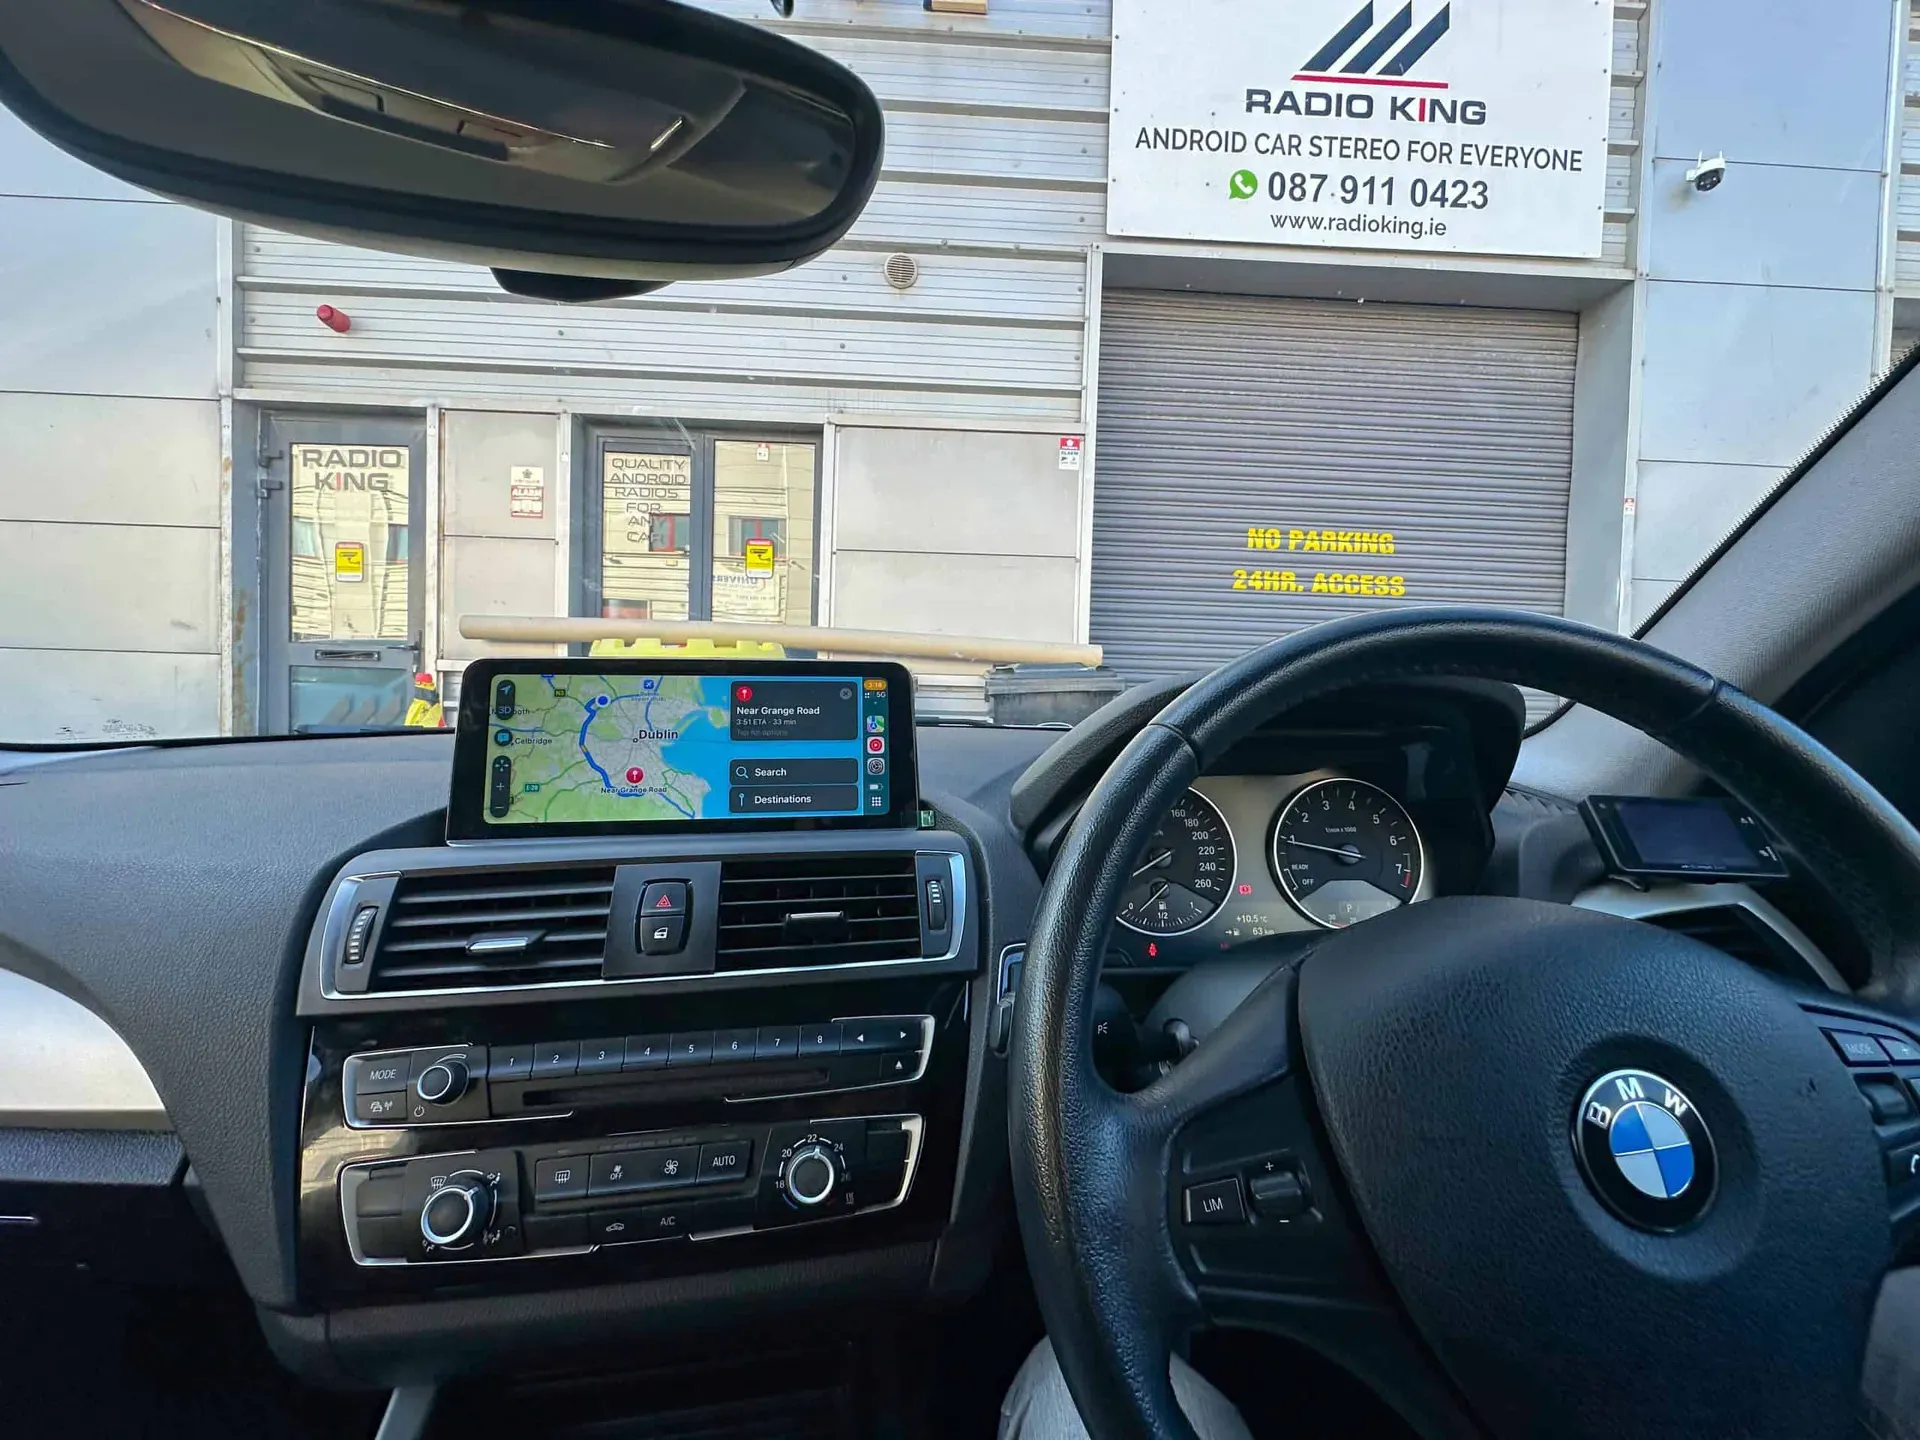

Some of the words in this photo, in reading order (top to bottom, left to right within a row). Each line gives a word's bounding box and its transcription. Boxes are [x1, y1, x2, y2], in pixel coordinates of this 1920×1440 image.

[1245, 88, 1374, 119] RADIO
[1390, 96, 1487, 126] KING
[1135, 126, 1247, 154] ANDROID
[1254, 133, 1302, 157] CAR
[1308, 135, 1400, 161] STEREO
[1407, 140, 1453, 165] FOR
[1459, 144, 1582, 172] EVERYONE
[1268, 171, 1327, 203] 087
[1340, 175, 1394, 206] 911
[1410, 179, 1489, 210] 0423
[1270, 211, 1447, 240] www.radioking.ie
[302, 449, 402, 468] RADIO
[611, 457, 686, 470] QUALITY
[314, 472, 389, 491] KING
[610, 473, 686, 485] ANDROID
[614, 487, 679, 498] RADIOS
[626, 502, 661, 513] FOR
[1247, 527, 1282, 550] NO
[1288, 529, 1395, 554] PARKING
[1231, 568, 1304, 592] 24HR.
[1310, 572, 1406, 597] ACCESS
[736, 706, 759, 715] Near
[760, 706, 795, 717] Grange
[796, 706, 821, 715] Road
[736, 718, 752, 726] 3:51
[753, 718, 767, 726] ETA
[772, 718, 782, 726] 33
[783, 718, 797, 726] min
[639, 729, 679, 740] Dublin
[514, 737, 553, 746] Celbridge
[754, 768, 787, 777] Search
[754, 795, 812, 805] Destinations
[1322, 800, 1331, 811] 3
[1348, 800, 1356, 811] 4
[1171, 809, 1186, 818] 160
[1301, 812, 1310, 823] 2
[1184, 818, 1199, 828] 180
[1372, 814, 1380, 825] 5
[1191, 831, 1209, 840] 200
[1389, 835, 1398, 846] 6
[1198, 846, 1215, 856] 220
[1199, 862, 1216, 871] 240
[1291, 863, 1309, 871] READY
[1395, 863, 1402, 875] 7
[1194, 879, 1212, 888] 260
[1301, 878, 1314, 886] OFF
[1128, 901, 1134, 910] 0
[1190, 901, 1194, 910] 1
[1158, 911, 1169, 920] 1/2
[1236, 914, 1260, 924] +10.5
[1252, 927, 1264, 936] 63
[774, 1038, 780, 1047] 7
[817, 1034, 823, 1044] 8
[688, 1044, 694, 1053] 5
[731, 1041, 738, 1051] 6
[598, 1050, 605, 1060] 3
[644, 1047, 651, 1056] 4
[509, 1057, 515, 1067] 1
[552, 1054, 559, 1064] 2
[369, 1068, 397, 1080] MODE
[1586, 1077, 1688, 1129] BMW
[807, 1134, 817, 1143] 22
[833, 1143, 844, 1152] 24
[781, 1148, 792, 1158] 20
[712, 1155, 736, 1167] AUTO
[610, 1171, 623, 1181] OFF
[775, 1180, 785, 1189] 18
[1202, 1197, 1224, 1213] LIM
[660, 1216, 675, 1226] A/C
